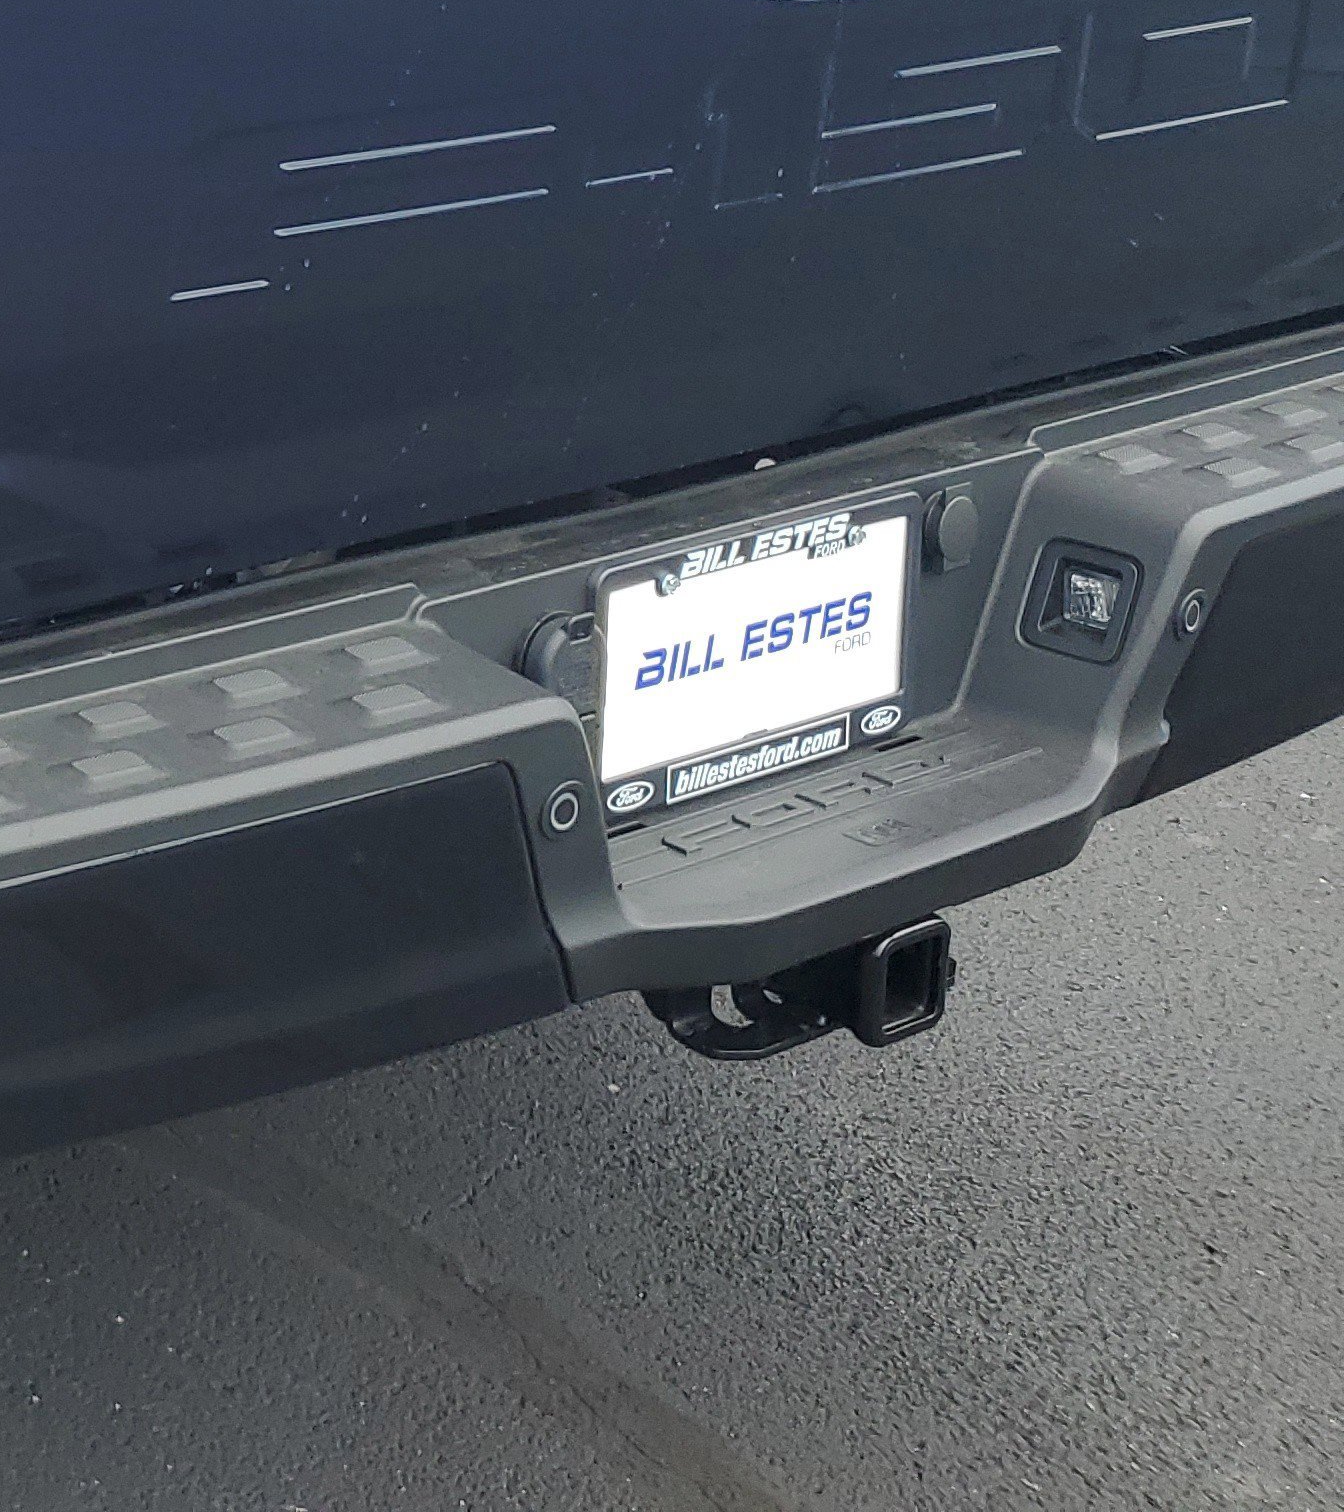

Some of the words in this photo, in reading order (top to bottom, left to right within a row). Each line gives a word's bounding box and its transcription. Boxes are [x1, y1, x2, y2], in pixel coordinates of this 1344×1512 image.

[680, 542, 745, 579] BILL
[751, 513, 851, 561] ESTES
[813, 540, 846, 559] FORD
[634, 634, 724, 690] BILL
[740, 591, 873, 662] ESTES
[834, 631, 872, 655] FORD
[674, 727, 842, 796] billestesford.com
